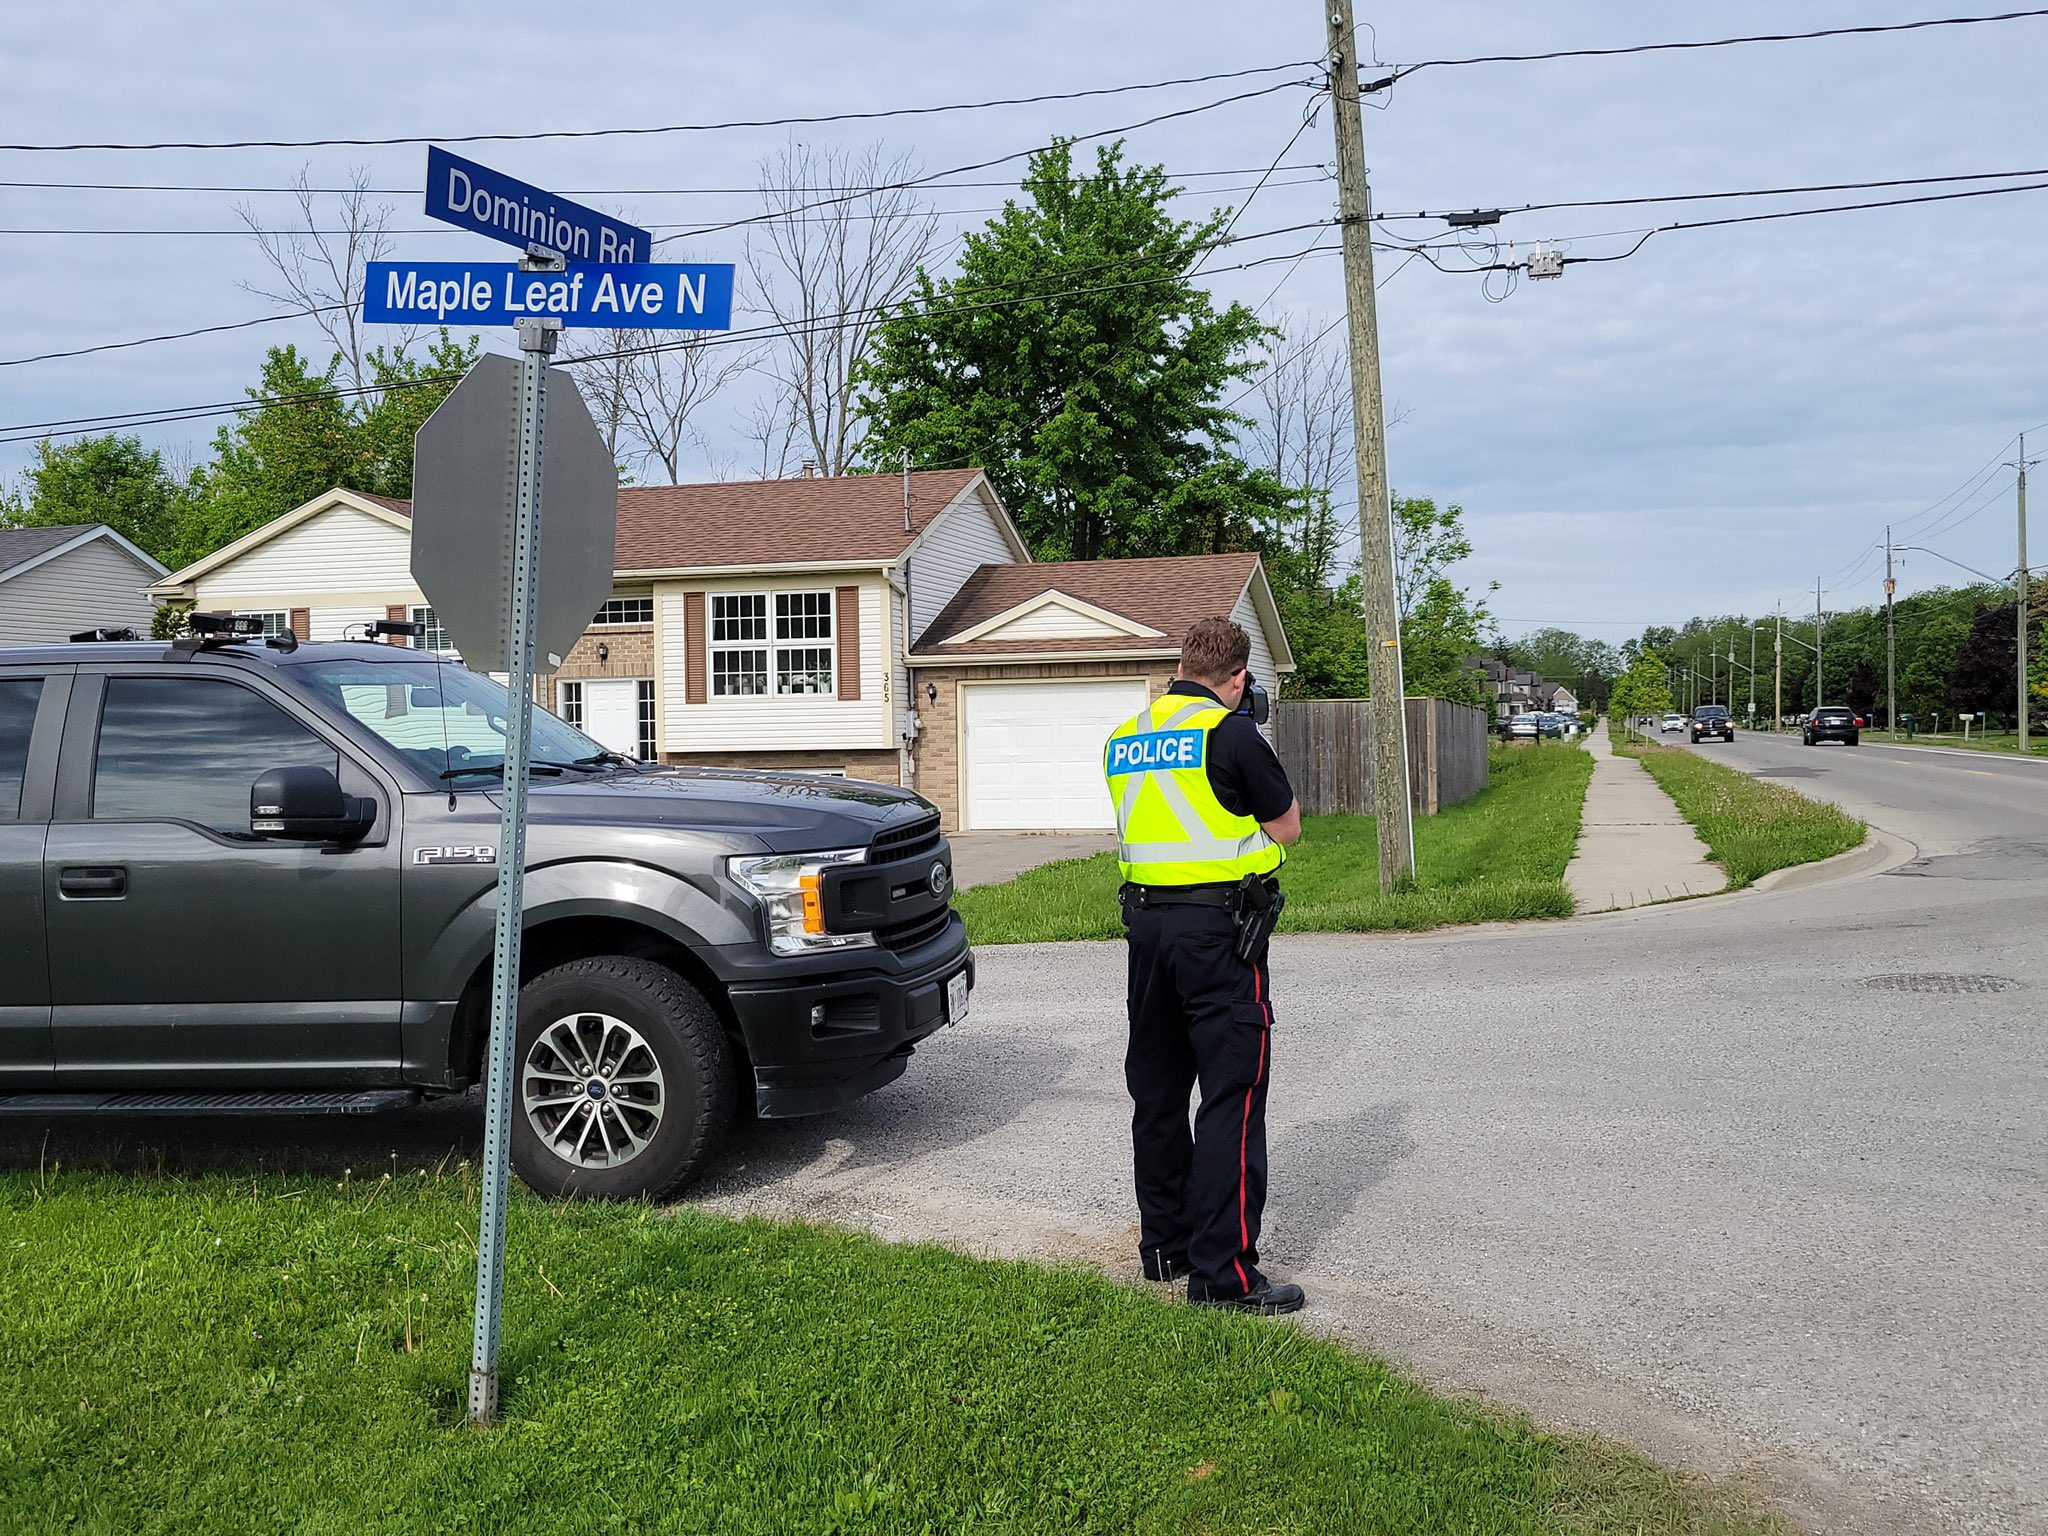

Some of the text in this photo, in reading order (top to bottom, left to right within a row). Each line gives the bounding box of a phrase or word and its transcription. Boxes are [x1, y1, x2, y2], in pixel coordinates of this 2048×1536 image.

[447, 167, 636, 264] Dominion Rd
[386, 271, 706, 320] Maple Leaf Ave N
[1114, 737, 1194, 767] POLICE
